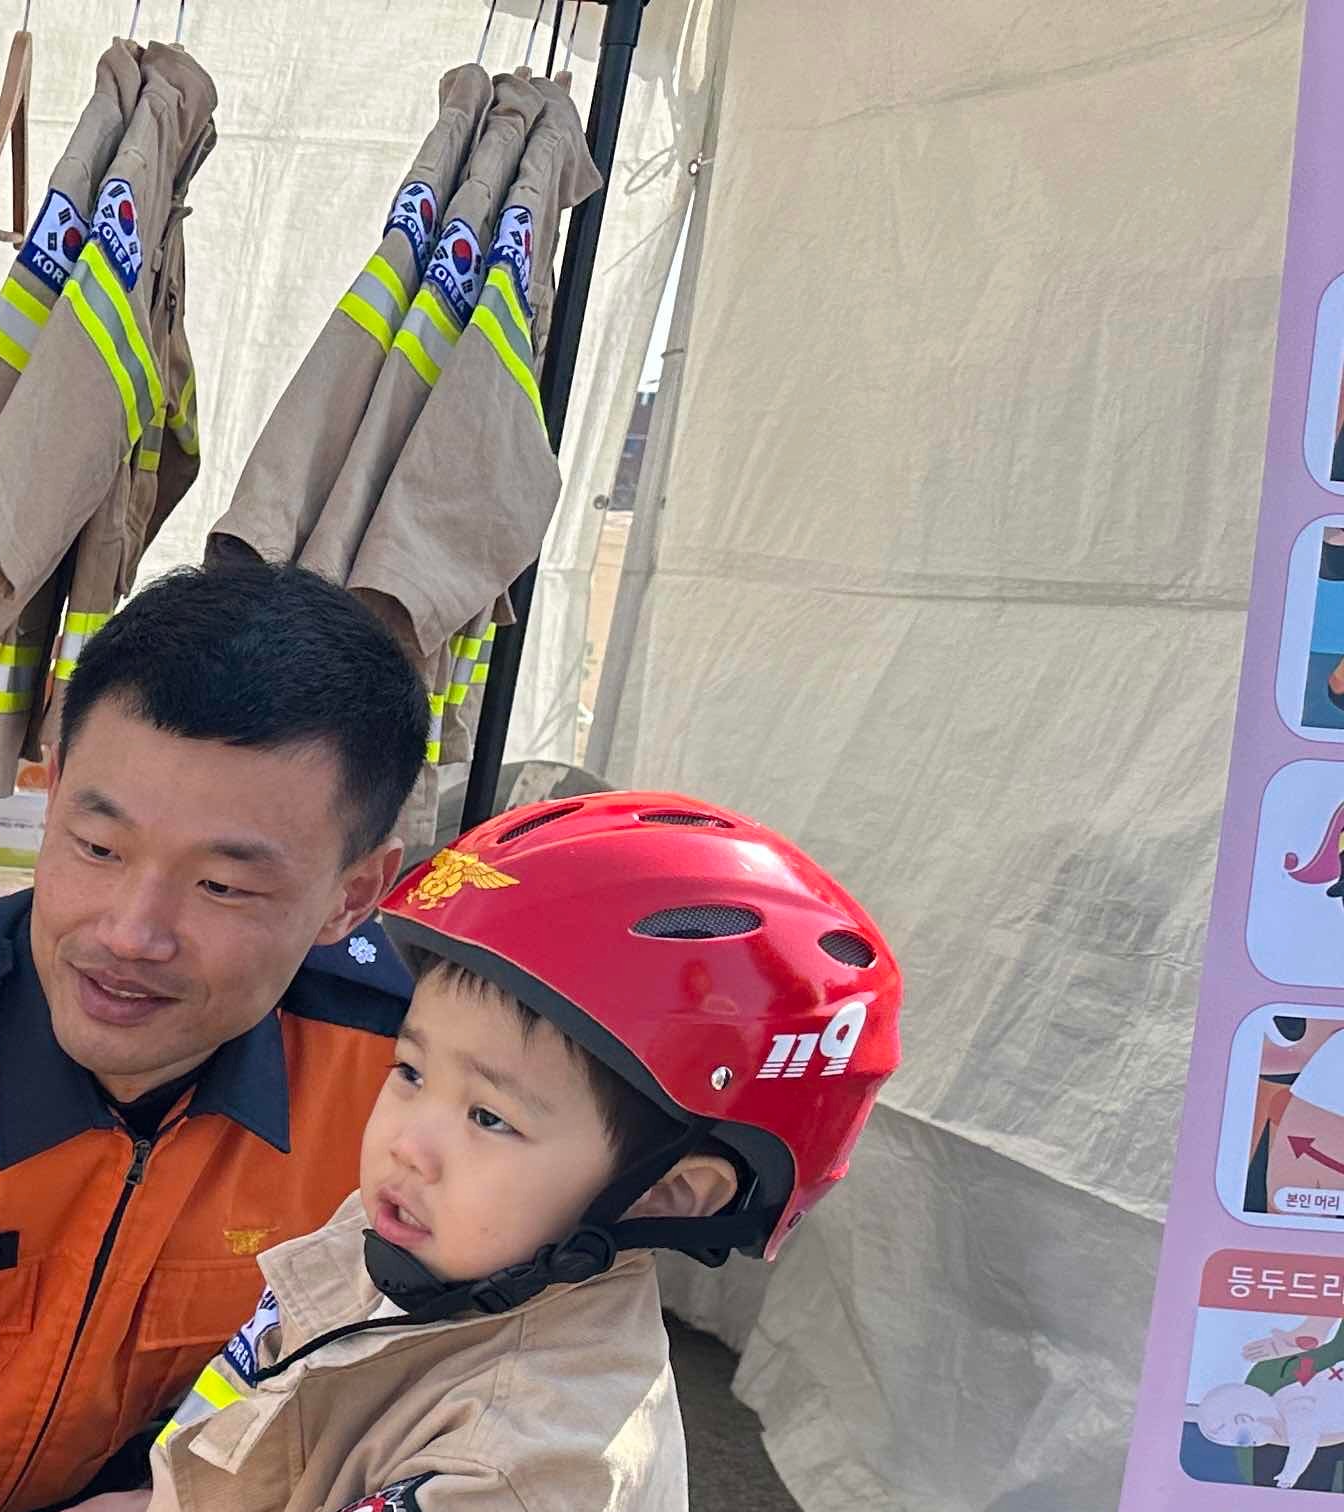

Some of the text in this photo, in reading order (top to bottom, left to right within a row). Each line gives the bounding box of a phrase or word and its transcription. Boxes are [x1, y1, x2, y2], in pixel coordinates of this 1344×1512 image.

[31, 250, 69, 285] KOR
[755, 1001, 867, 1079] 119
[1286, 1192, 1340, 1211] 본인 머리
[227, 1336, 252, 1376] OREA
